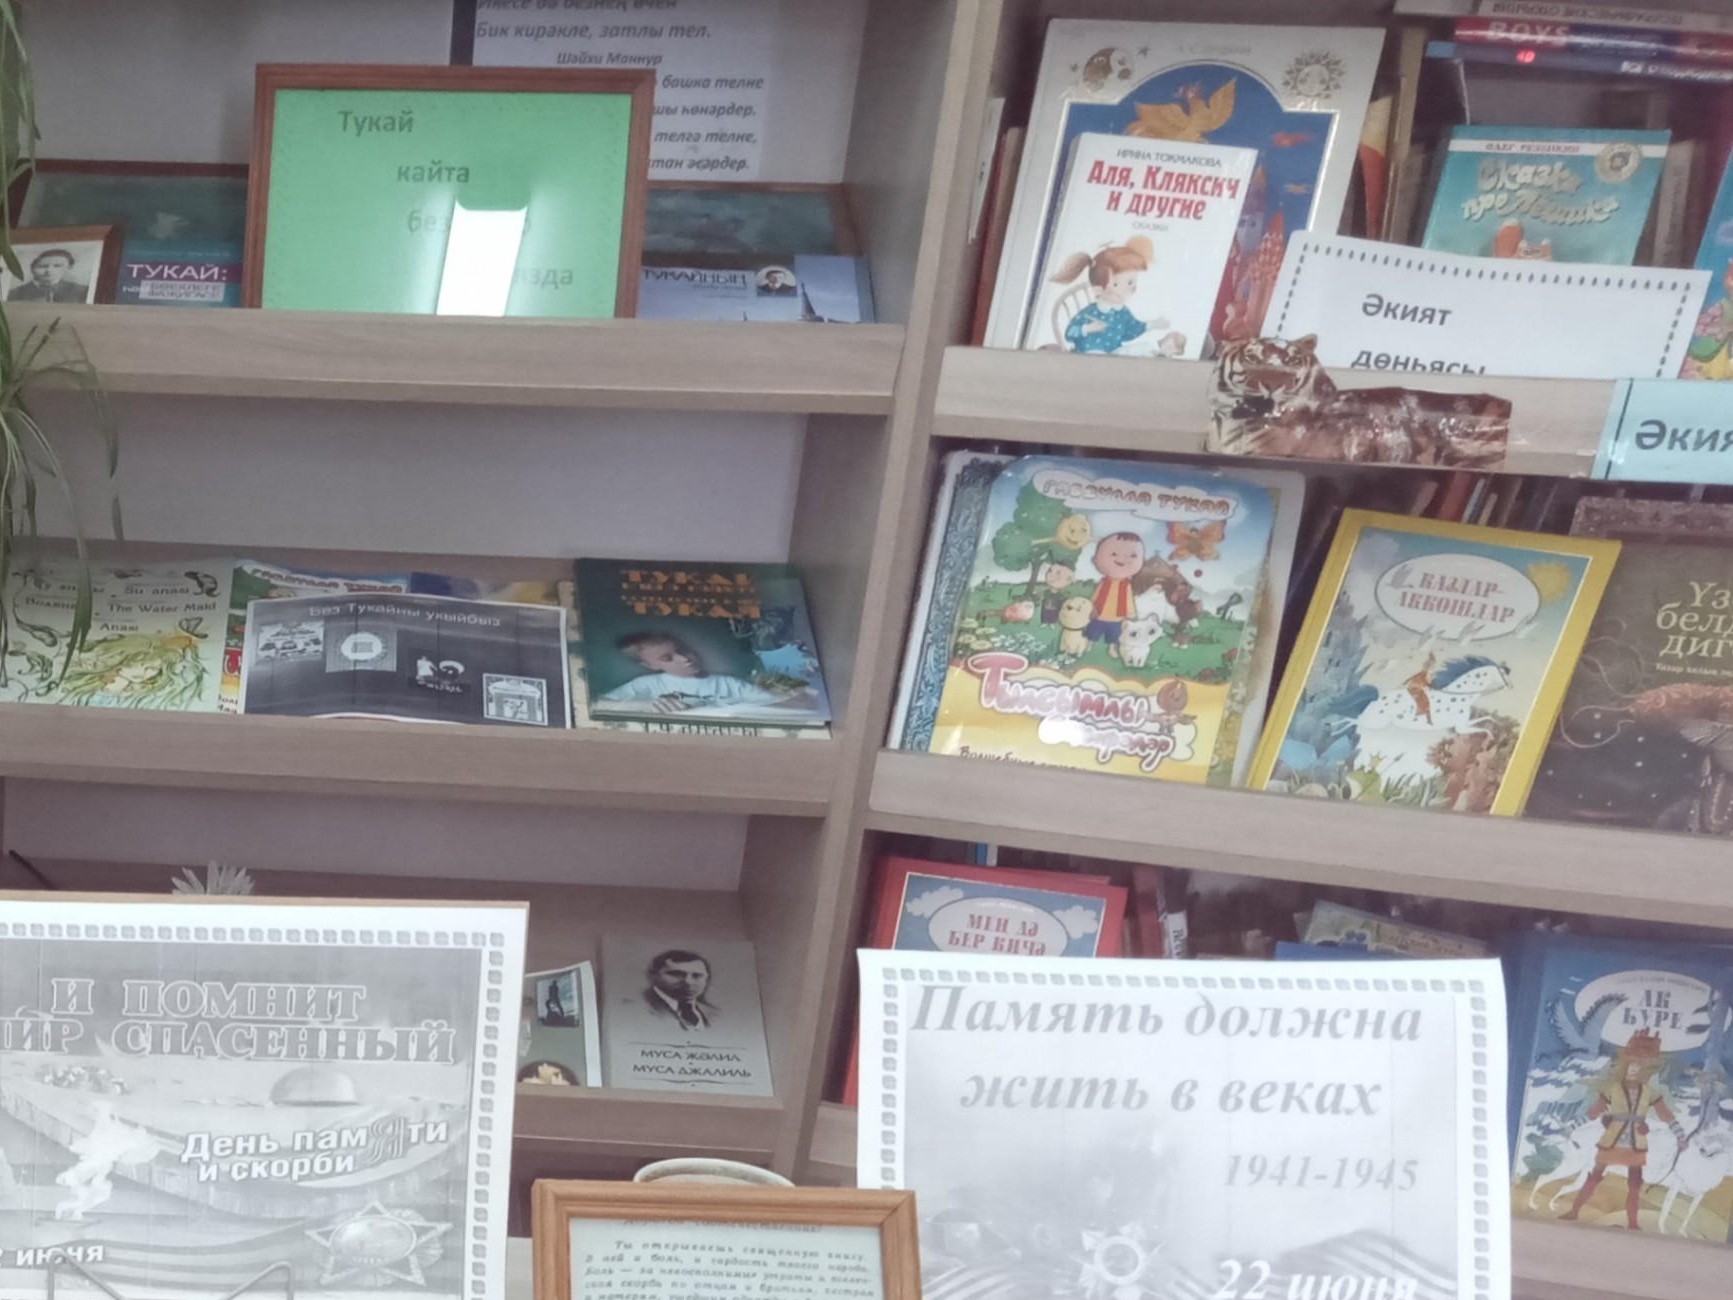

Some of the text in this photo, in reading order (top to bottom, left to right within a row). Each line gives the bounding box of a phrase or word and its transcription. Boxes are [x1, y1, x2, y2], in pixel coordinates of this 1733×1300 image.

[476, 21, 509, 38] Бик
[668, 24, 711, 39] тел.
[714, 77, 764, 90] телне
[338, 109, 414, 137] Тукай
[397, 160, 471, 183] кайта
[1155, 153, 1222, 168] ТОКМАКОВА
[1087, 160, 1241, 199] Аля, Кляксич
[1125, 193, 1206, 220] другие
[127, 263, 227, 281] ТУКАЙ:
[1361, 294, 1452, 326] Әкият
[51, 978, 366, 1022] И ПОМНИТ
[910, 984, 1422, 1042] Память должна
[112, 1020, 456, 1065] СПАСЕННЫЙ
[640, 1048, 683, 1062] МУСА
[633, 1064, 751, 1078] МУСА ДЖАЛИЛЬ
[959, 1073, 1381, 1116] жить в веках
[181, 1131, 278, 1163] День
[199, 1153, 354, 1185] и скорби
[1223, 1154, 1419, 1192] 1941-1945
